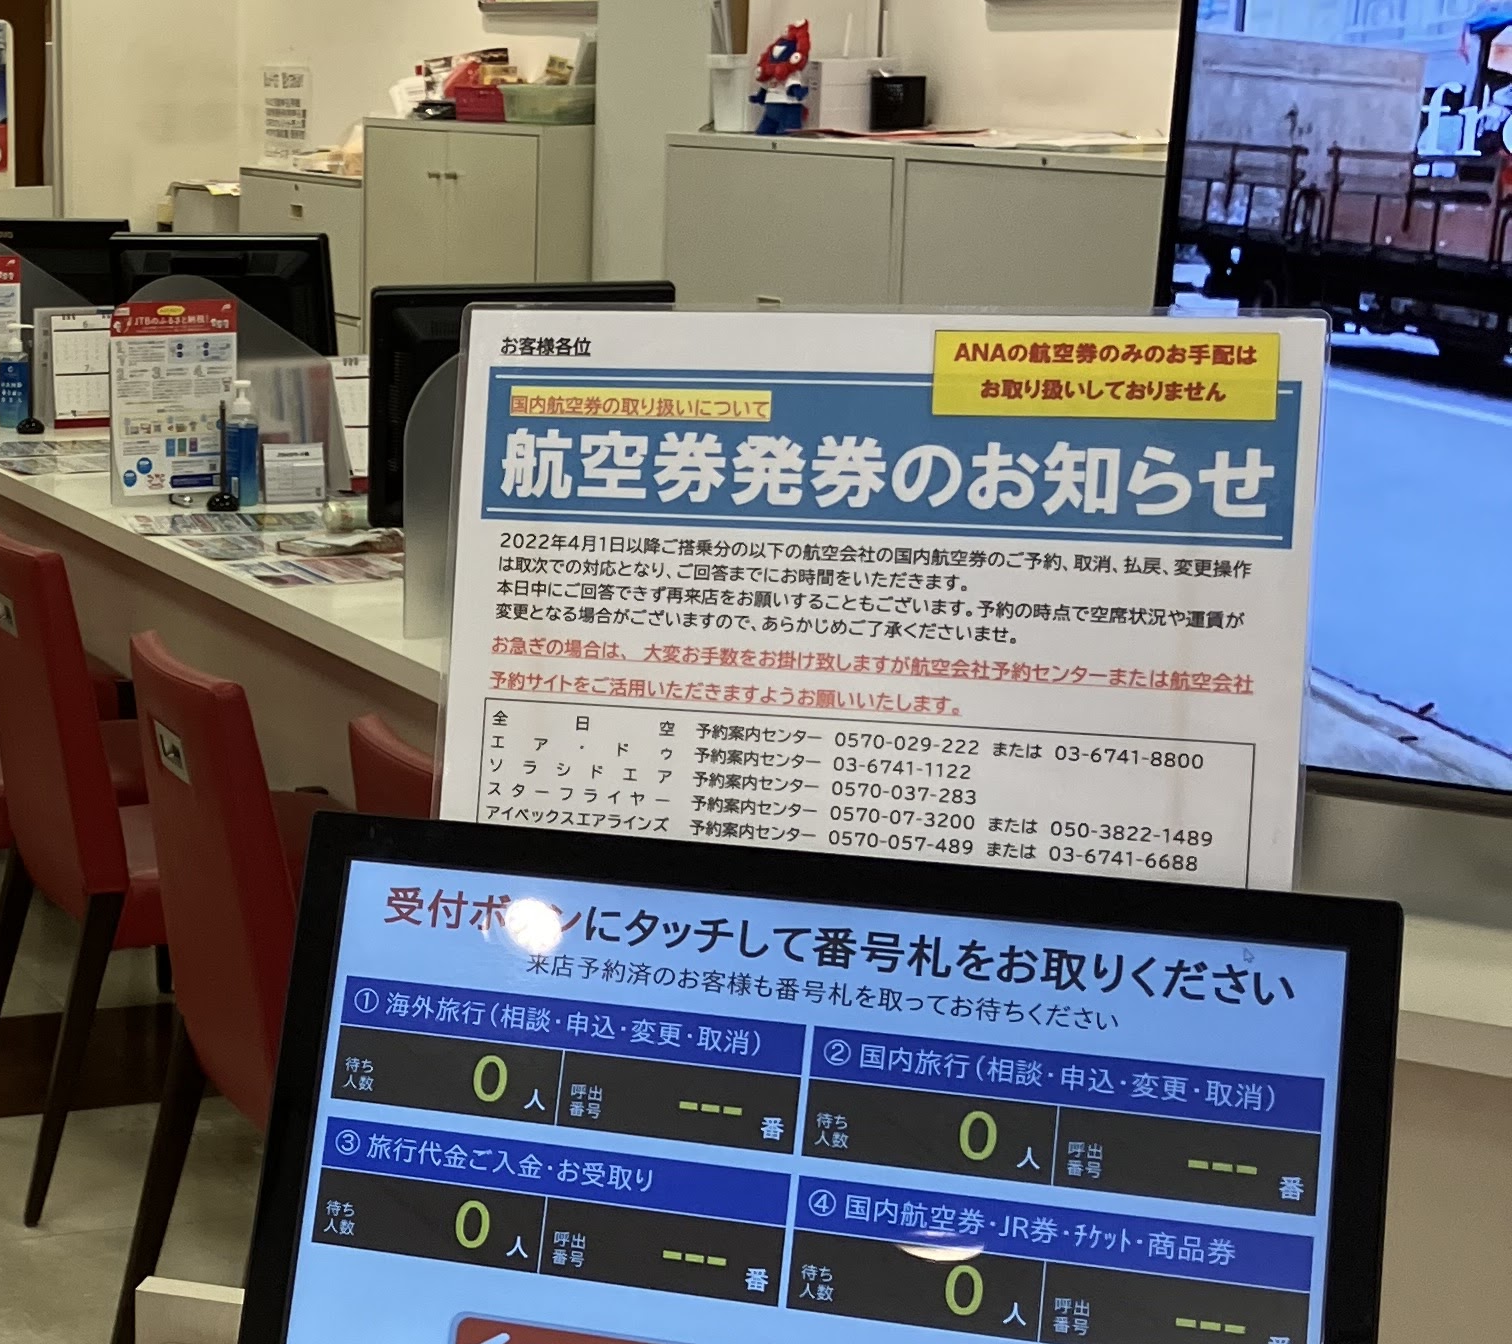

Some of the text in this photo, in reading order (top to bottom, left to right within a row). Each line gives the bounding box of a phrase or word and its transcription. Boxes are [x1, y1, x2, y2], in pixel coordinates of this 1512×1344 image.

[500, 336, 591, 356] お客様各位
[954, 342, 1257, 365] ANAの航空券のみのお手配は
[979, 379, 1227, 403] お取り扱いしておりません
[510, 394, 771, 419] 国内航空券の取り扱いについて
[500, 427, 1276, 519] 航空券発券のお知らせ
[500, 532, 1252, 580] 2022年4月1日以降ご搭乗分の以下の航空会社の国内航空券のご予約、取消、払戻、変更操作
[498, 555, 969, 593] は取次での対応となり、ご回答までにお時間をいただきます。
[496, 579, 1245, 630] 本日中にご回答できず再来店をお願いすることもございます。予約の時点で空席状況や運賃が
[495, 602, 1018, 646] 変更となる場合がございますので、あらかじめご了承くださいませ。
[489, 670, 962, 715] 予約サイトをご活用いただきますようお願いいたします。
[695, 722, 822, 744] 予約案内センター
[835, 731, 980, 756] 0570-029-222
[992, 742, 1043, 761] または
[1054, 745, 1204, 770] 03-6741-8800
[694, 746, 821, 768] 予約案内センター
[833, 756, 972, 781] 03-6741-1122
[692, 770, 820, 792] 予約案内センター
[831, 780, 977, 806] 0570-037-283
[690, 794, 818, 817] 予約案内センター
[830, 805, 976, 831] 0570-07-3200
[988, 817, 1038, 836] または
[1050, 820, 1213, 848] 050-3822-1489
[486, 804, 1199, 873] アイベックスエアラインズ 予約案内センター 0570-057-489 または 03-6741-6688
[384, 885, 1296, 1008] 受付ボンにタッチして番号札をお取りください
[526, 953, 1119, 1033] 来店予約済のお客様も番号札を取ってお待ちください
[345, 1056, 374, 1074] 待ち
[343, 1074, 375, 1093] 人数
[472, 1054, 547, 1113] 0 人
[570, 1083, 604, 1103] 呼出
[569, 1102, 603, 1121] 番号
[815, 1112, 849, 1130] 待ち
[760, 1117, 785, 1142] 番
[813, 1131, 849, 1151] 人数
[958, 1109, 1041, 1171] 0 人
[367, 1134, 654, 1193] 旅行代金ご入金・お受取り
[1067, 1141, 1104, 1161] 呼出
[1066, 1159, 1103, 1180] 番号
[1278, 1176, 1305, 1202] 番
[325, 1200, 356, 1217] 待ち
[323, 1218, 356, 1237] 人数
[454, 1200, 529, 1260] 0 人
[553, 1231, 587, 1250] 呼出
[552, 1249, 586, 1269] 番号
[744, 1268, 769, 1293] 番
[800, 1264, 834, 1283] 待ち
[799, 1284, 834, 1304] 人数
[944, 1264, 1027, 1327] 0 人
[1054, 1297, 1090, 1317] 呼出
[1053, 1316, 1090, 1337] 番号
